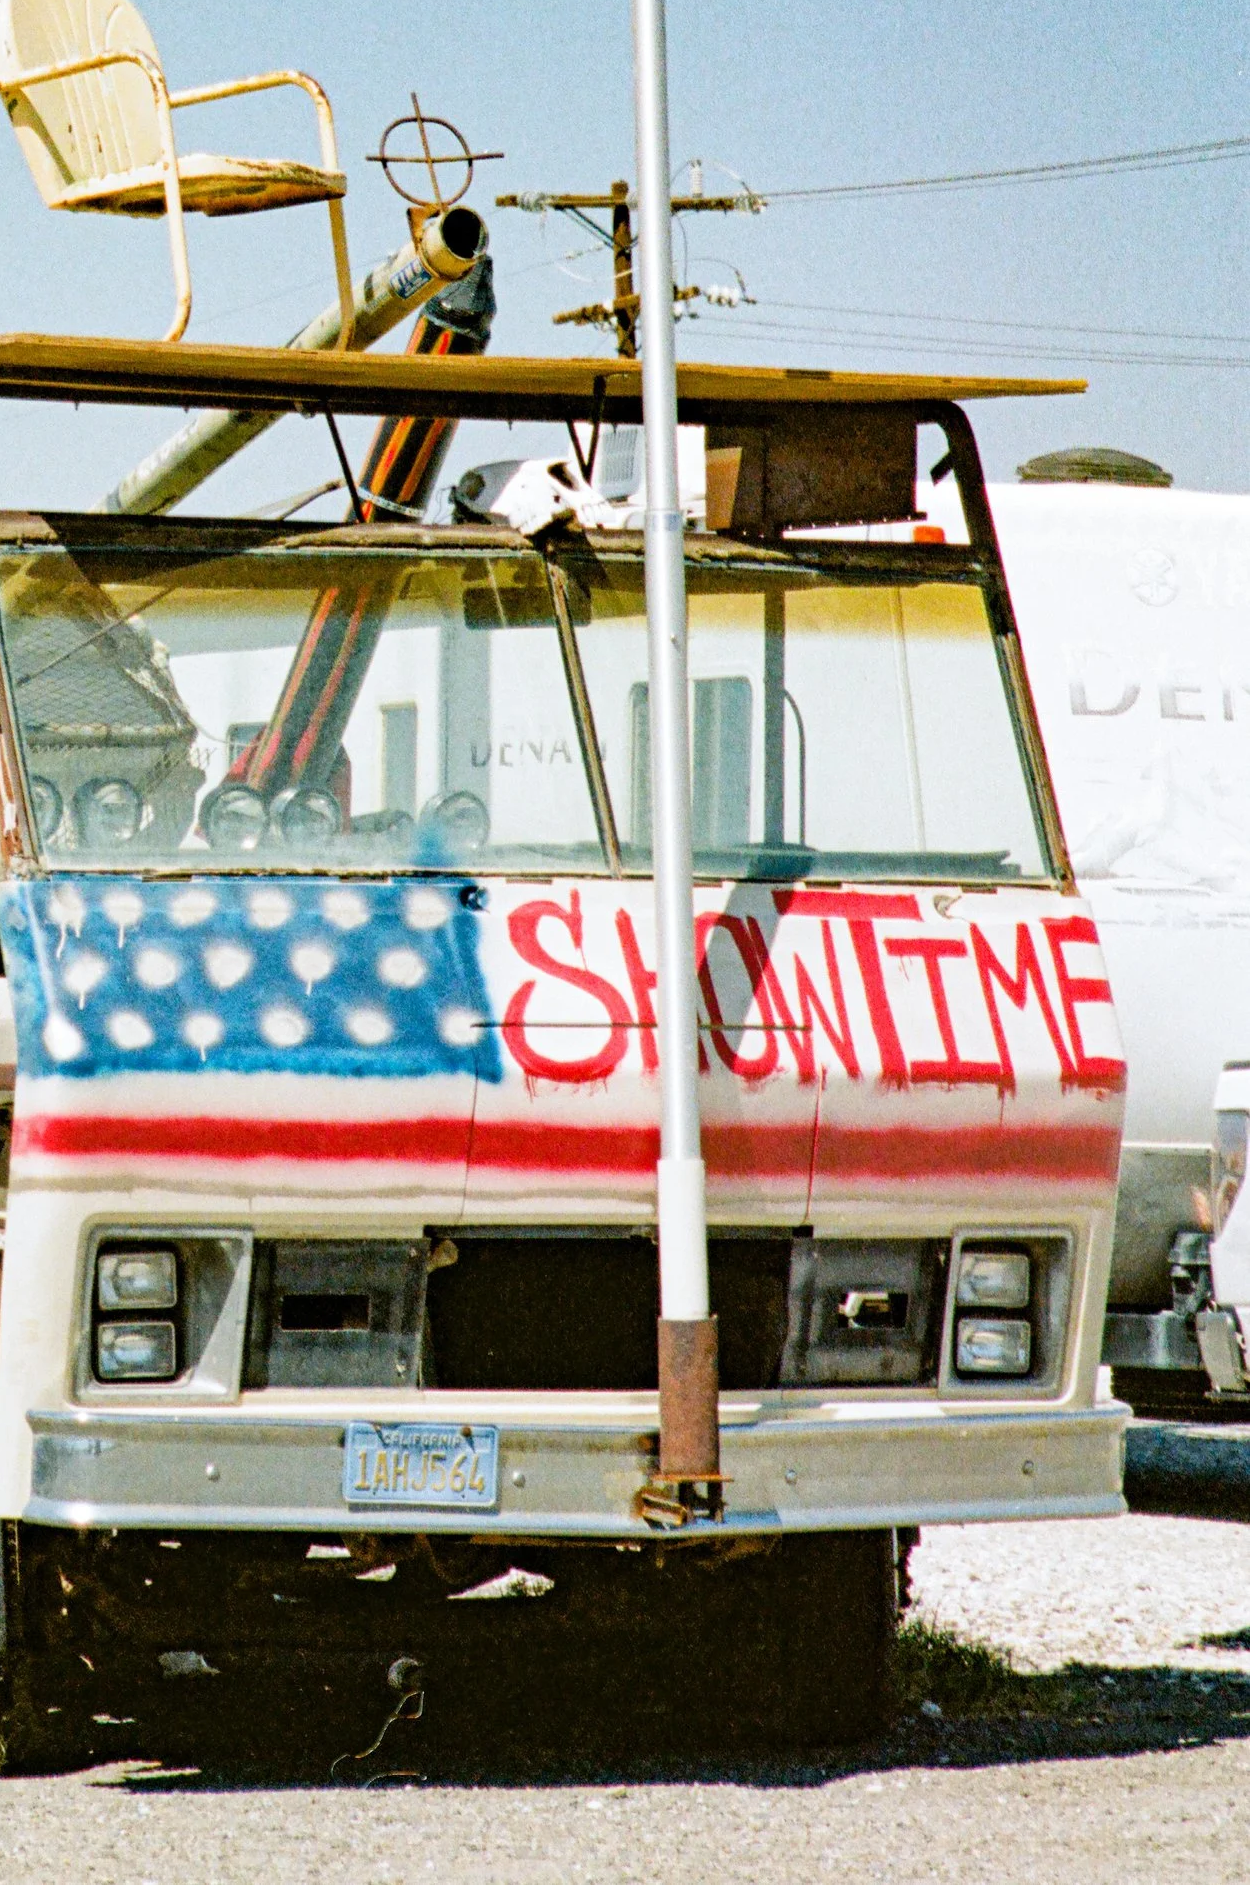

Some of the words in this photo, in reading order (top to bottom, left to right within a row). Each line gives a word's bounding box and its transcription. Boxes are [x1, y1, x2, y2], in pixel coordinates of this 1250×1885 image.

[502, 887, 1128, 1093] SHOWTIME
[383, 1432, 463, 1449] CALIFORNIA
[354, 1449, 485, 1493] 1AHJ564
